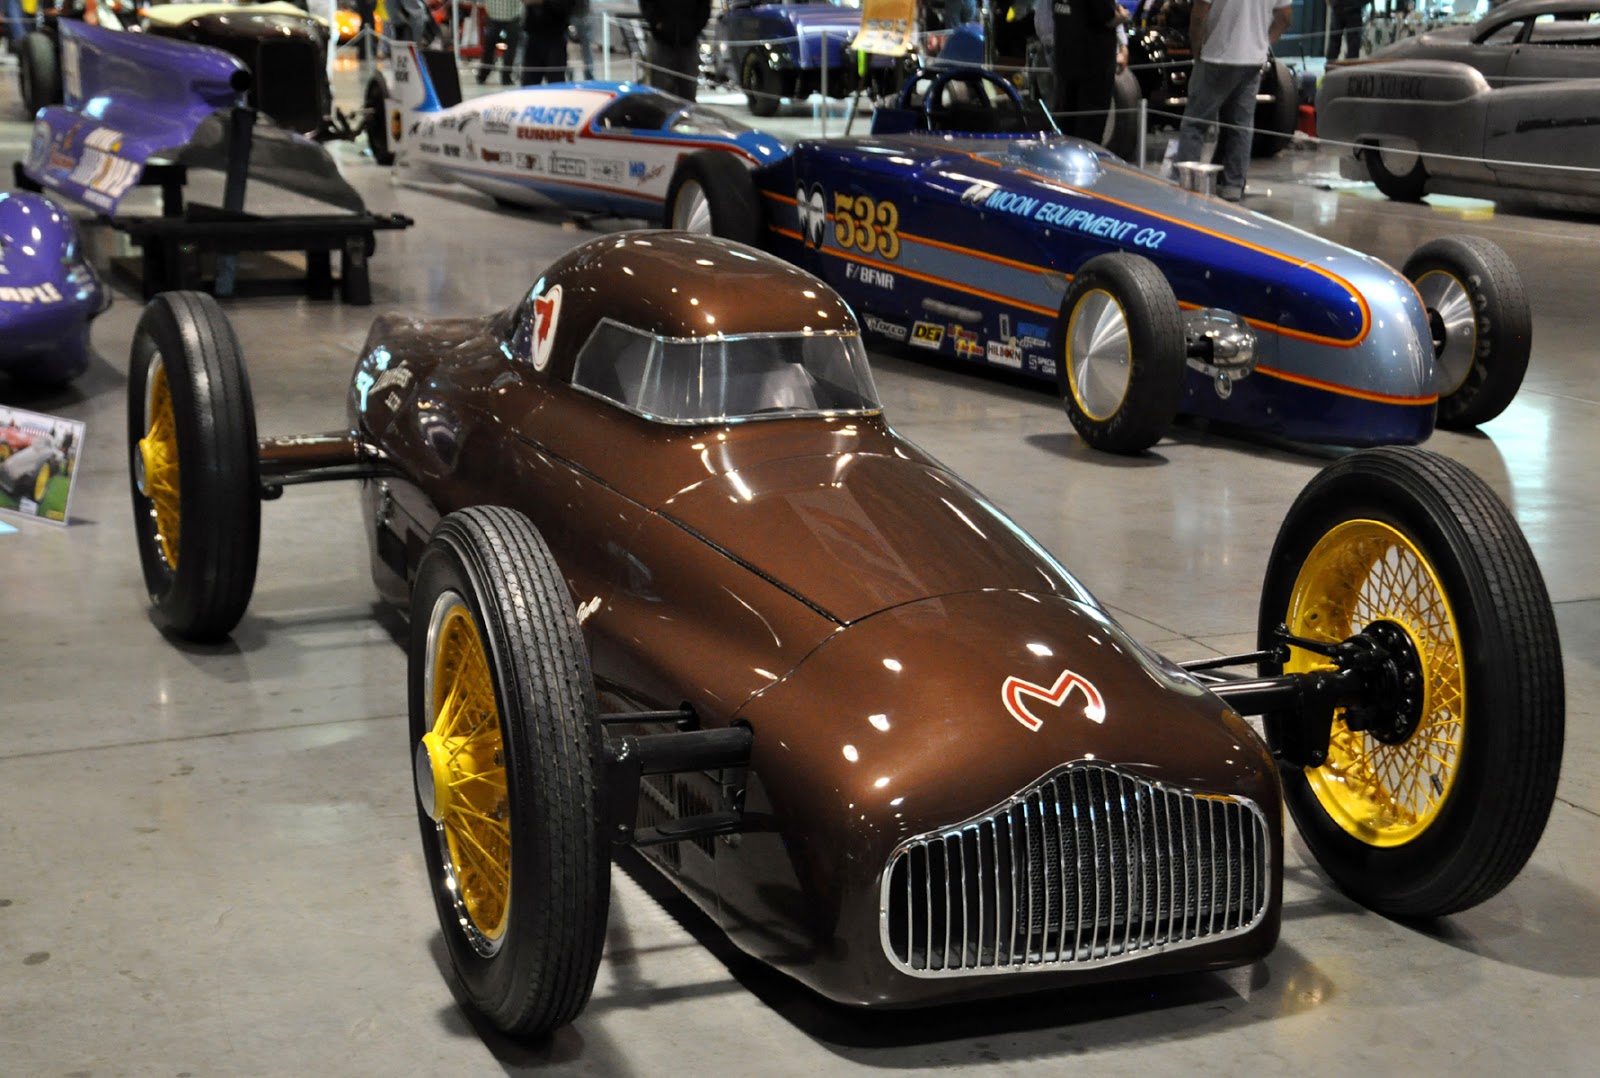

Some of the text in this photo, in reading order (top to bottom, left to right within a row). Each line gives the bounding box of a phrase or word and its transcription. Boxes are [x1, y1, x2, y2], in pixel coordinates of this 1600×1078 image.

[520, 105, 583, 127] PARTS
[516, 126, 576, 144] EUROPE
[833, 190, 900, 261] 533
[985, 189, 1167, 249] MOON EQUIPMENT CO.
[534, 297, 556, 351] 7
[914, 323, 943, 343] DEI
[987, 343, 1022, 361] HILBORN
